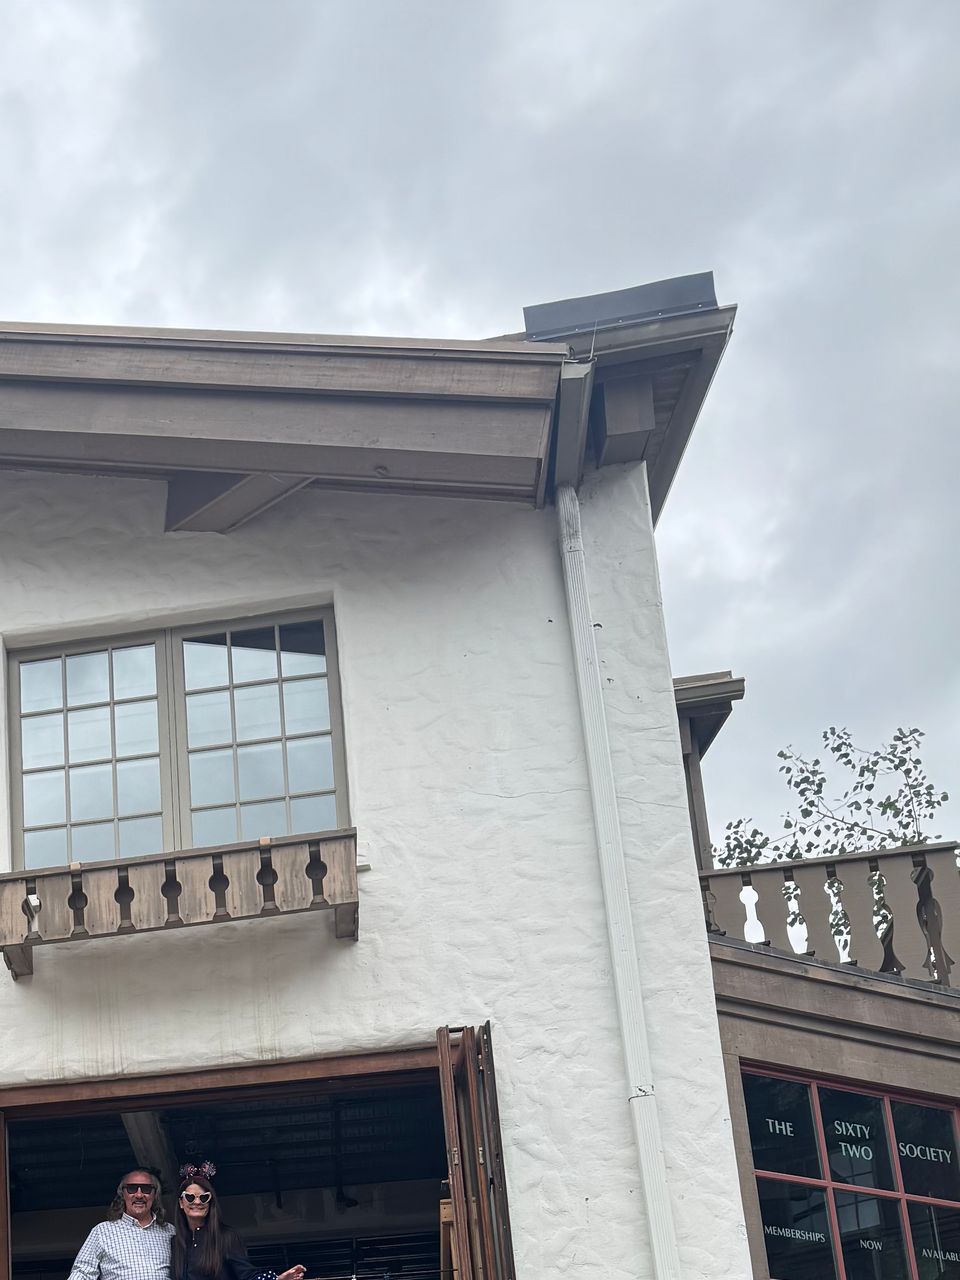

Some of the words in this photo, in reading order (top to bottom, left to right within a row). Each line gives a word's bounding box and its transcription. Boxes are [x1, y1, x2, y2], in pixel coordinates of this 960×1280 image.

[766, 1118, 794, 1137] THE
[834, 1120, 870, 1140] SIXTY
[839, 1142, 873, 1161] TWO
[899, 1142, 952, 1164] SOCIETY
[764, 1225, 826, 1243] MEMBERSHIPS
[860, 1239, 883, 1251] NOW
